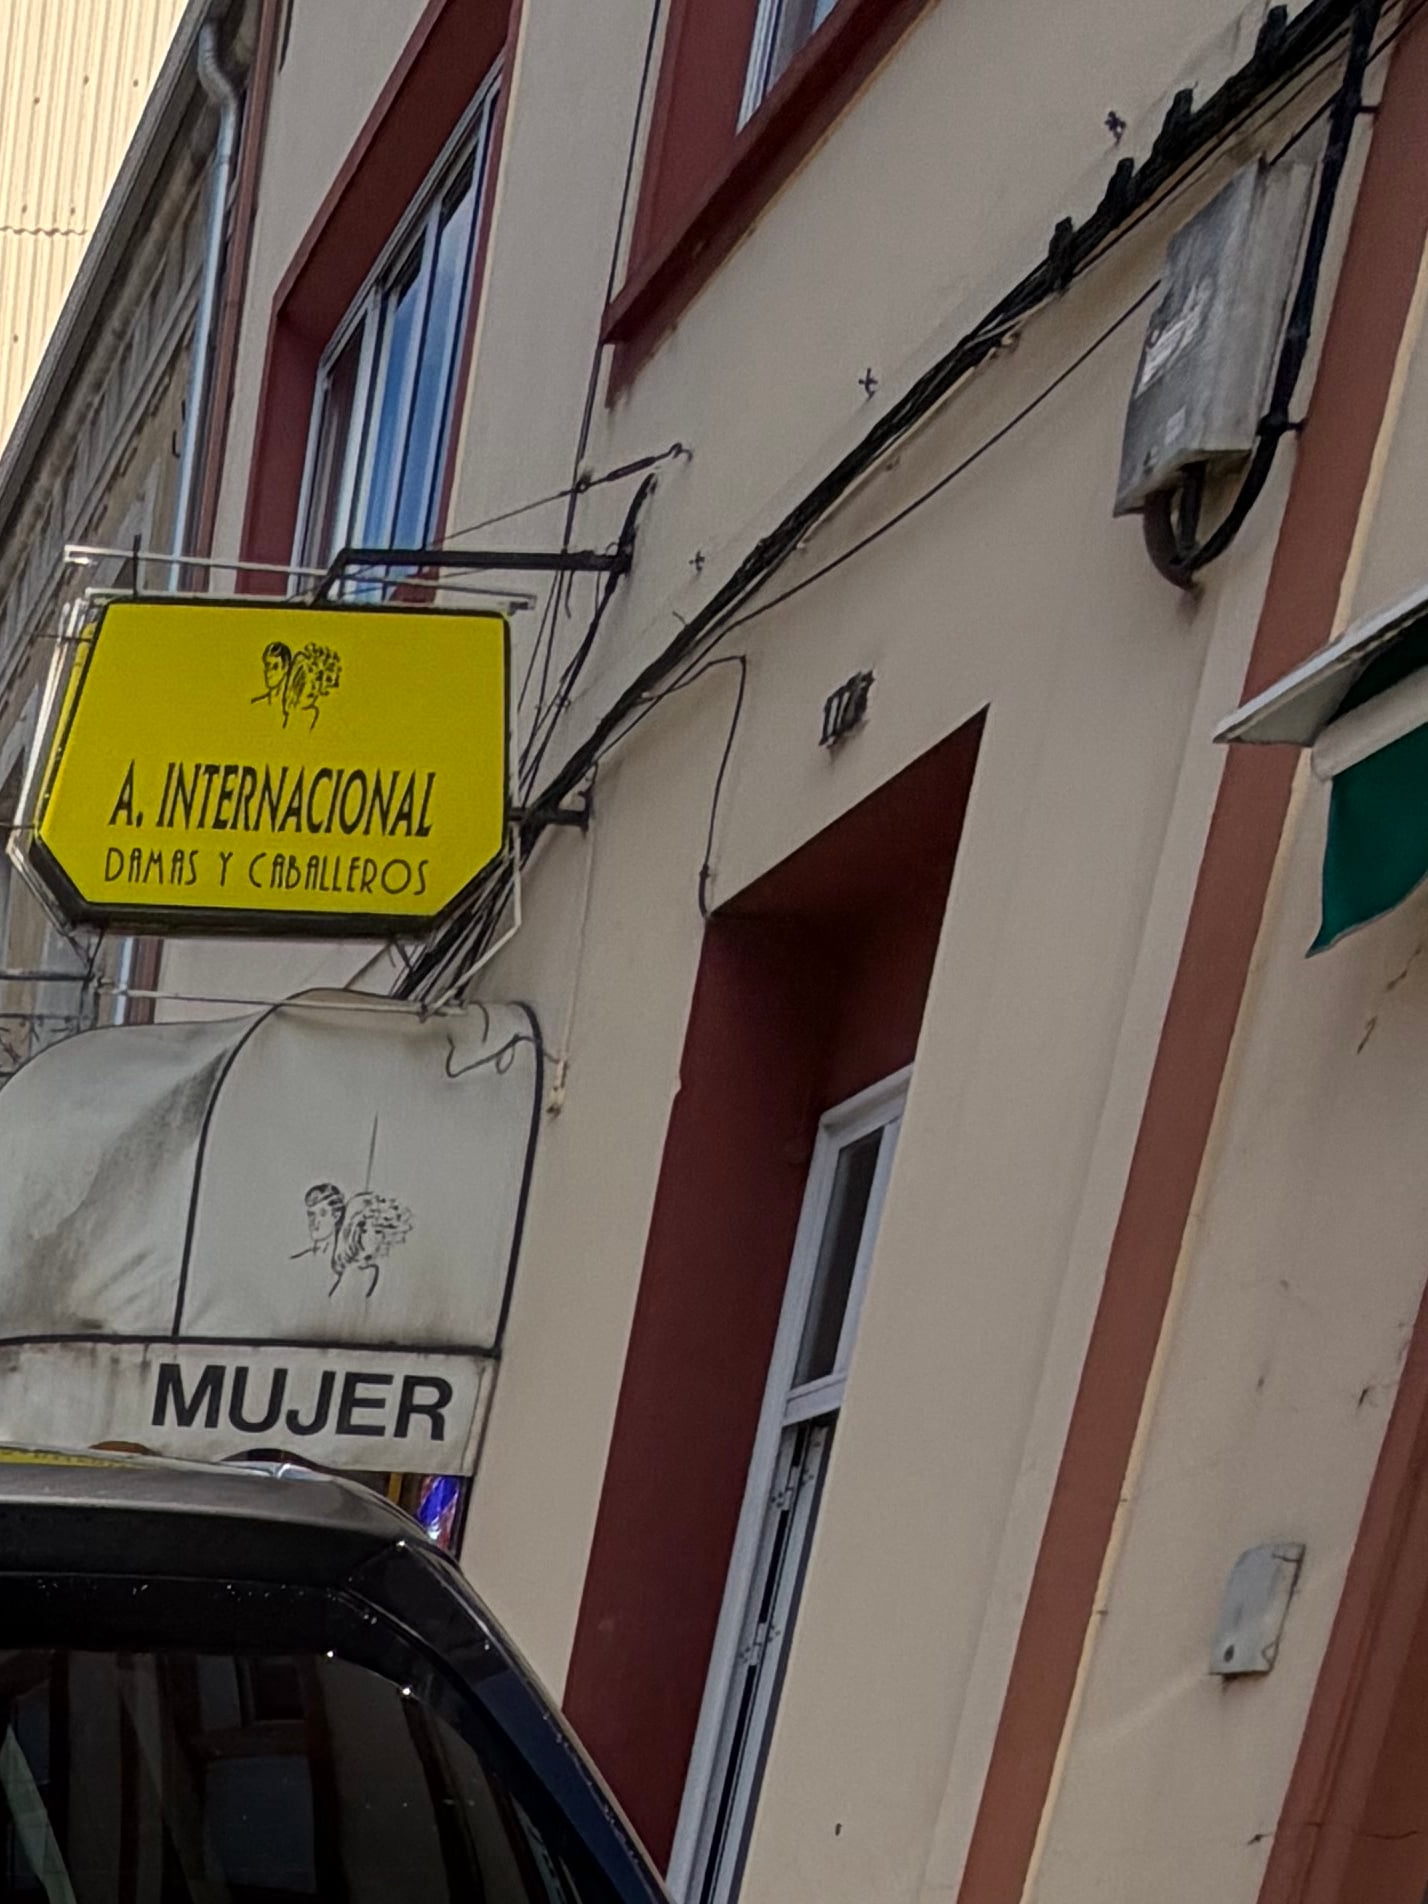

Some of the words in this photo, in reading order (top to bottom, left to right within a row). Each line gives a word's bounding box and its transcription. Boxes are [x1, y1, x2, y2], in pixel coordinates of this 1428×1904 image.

[156, 762, 436, 837] INTERNACIONAL
[104, 847, 199, 887] DAMAS
[219, 852, 233, 887] Y
[249, 853, 429, 896] CABALLEROS
[150, 1362, 454, 1441] MUJER
